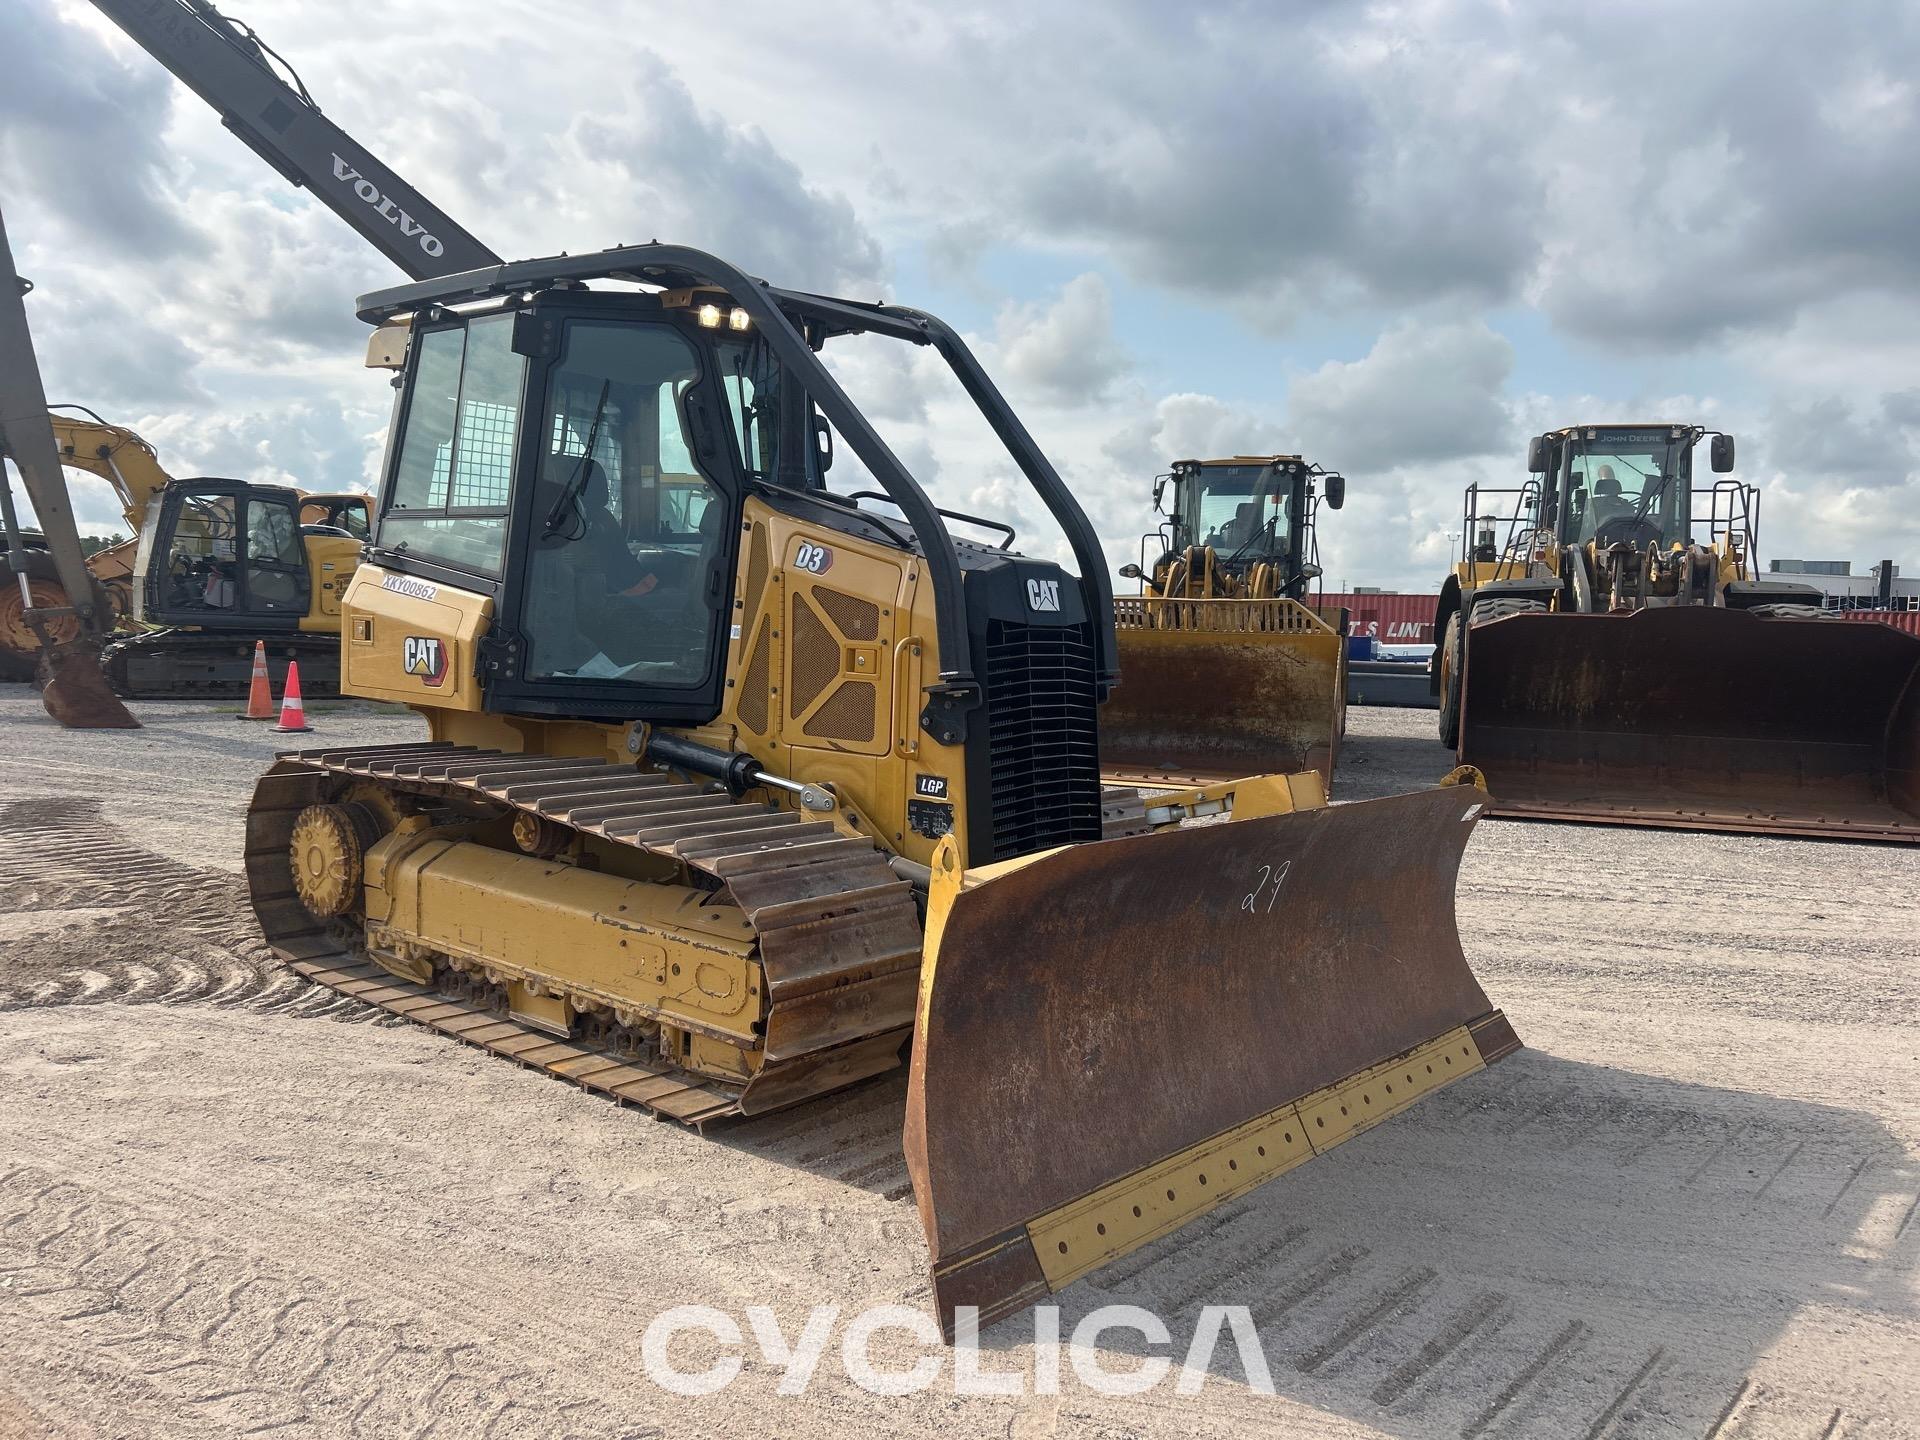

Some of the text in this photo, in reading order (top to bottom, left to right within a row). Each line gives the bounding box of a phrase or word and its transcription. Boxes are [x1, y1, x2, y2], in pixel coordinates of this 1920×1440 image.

[331, 152, 444, 257] VOLVO
[1600, 434, 1662, 443] JOHN DEERE
[795, 542, 824, 572] D3
[383, 575, 437, 600] XKY00862
[1026, 578, 1060, 612] CAT
[404, 637, 438, 676] CAT
[921, 778, 943, 793] LGP
[1241, 860, 1291, 914] 29
